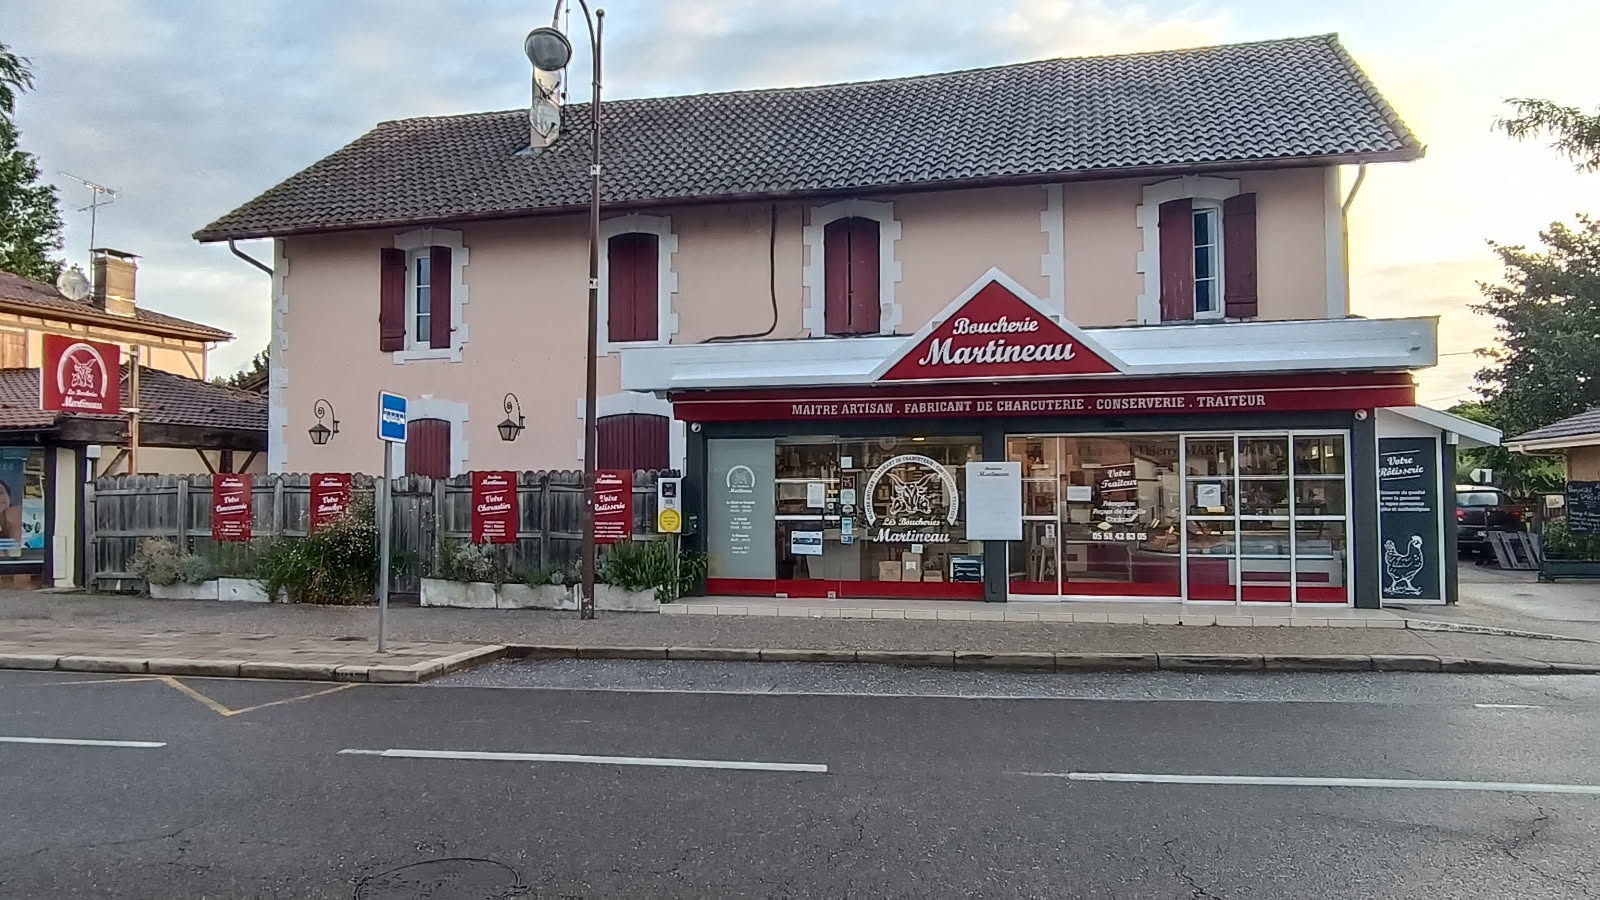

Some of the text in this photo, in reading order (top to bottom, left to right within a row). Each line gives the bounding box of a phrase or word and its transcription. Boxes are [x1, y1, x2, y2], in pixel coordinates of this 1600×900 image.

[953, 316, 1039, 335] Boucherie
[919, 338, 1075, 366] Martineau
[841, 402, 893, 414] ARTISAN
[904, 401, 972, 413] FABRICANT
[976, 400, 993, 412] DE
[996, 398, 1084, 411] CHARCUTERIE
[1096, 397, 1185, 410] CONSERVERIE
[1197, 394, 1266, 407] TRAITEUR
[1387, 456, 1413, 466] Votre
[1107, 469, 1132, 478] Votre
[1100, 479, 1138, 488] Traiteur
[882, 516, 941, 526] Les Boucheries
[872, 528, 951, 542] Martineau
[1092, 532, 1102, 540] 05
[1137, 532, 1148, 540] 05
